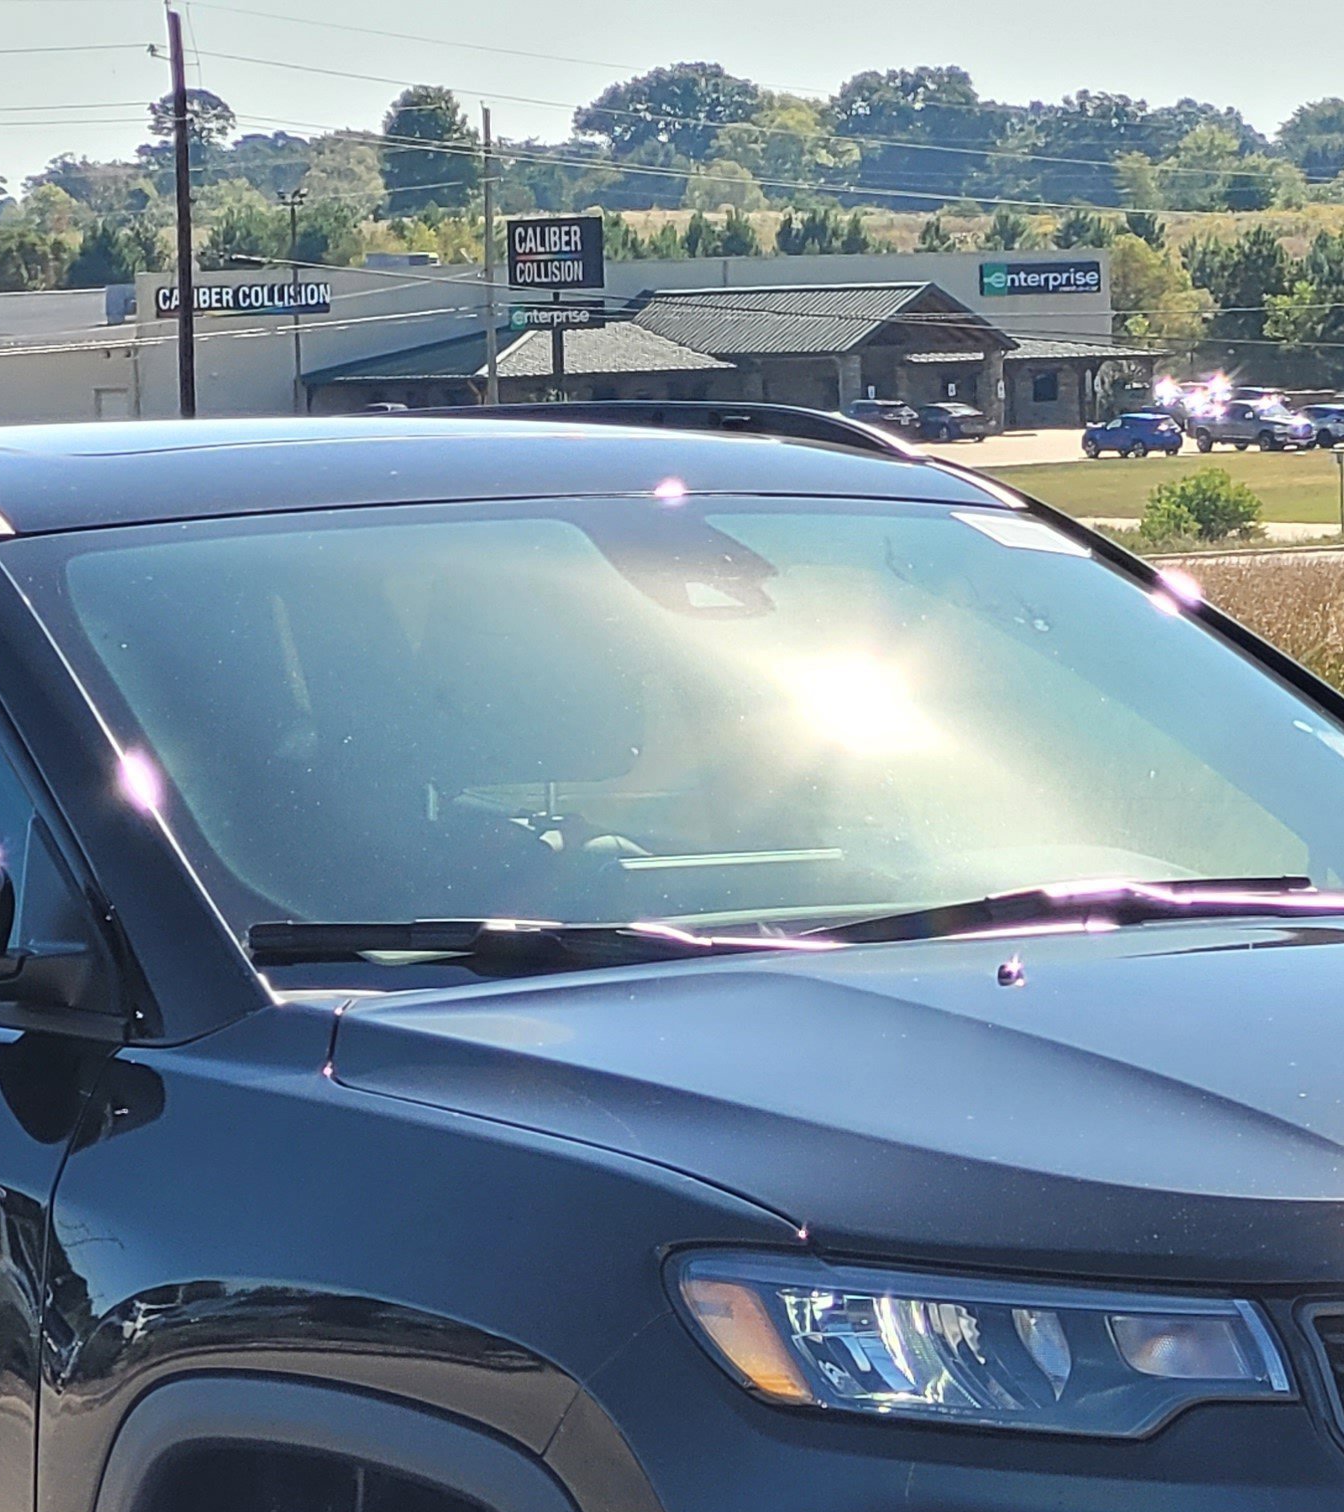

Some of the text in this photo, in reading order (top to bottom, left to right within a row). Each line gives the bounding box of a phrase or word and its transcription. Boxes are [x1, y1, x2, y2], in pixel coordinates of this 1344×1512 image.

[515, 225, 582, 253] CALIBER
[516, 260, 584, 283] COLLISION
[983, 267, 1099, 291] enterprise
[158, 284, 331, 310] CAIBER COLLISION
[512, 308, 590, 328] enterprise
